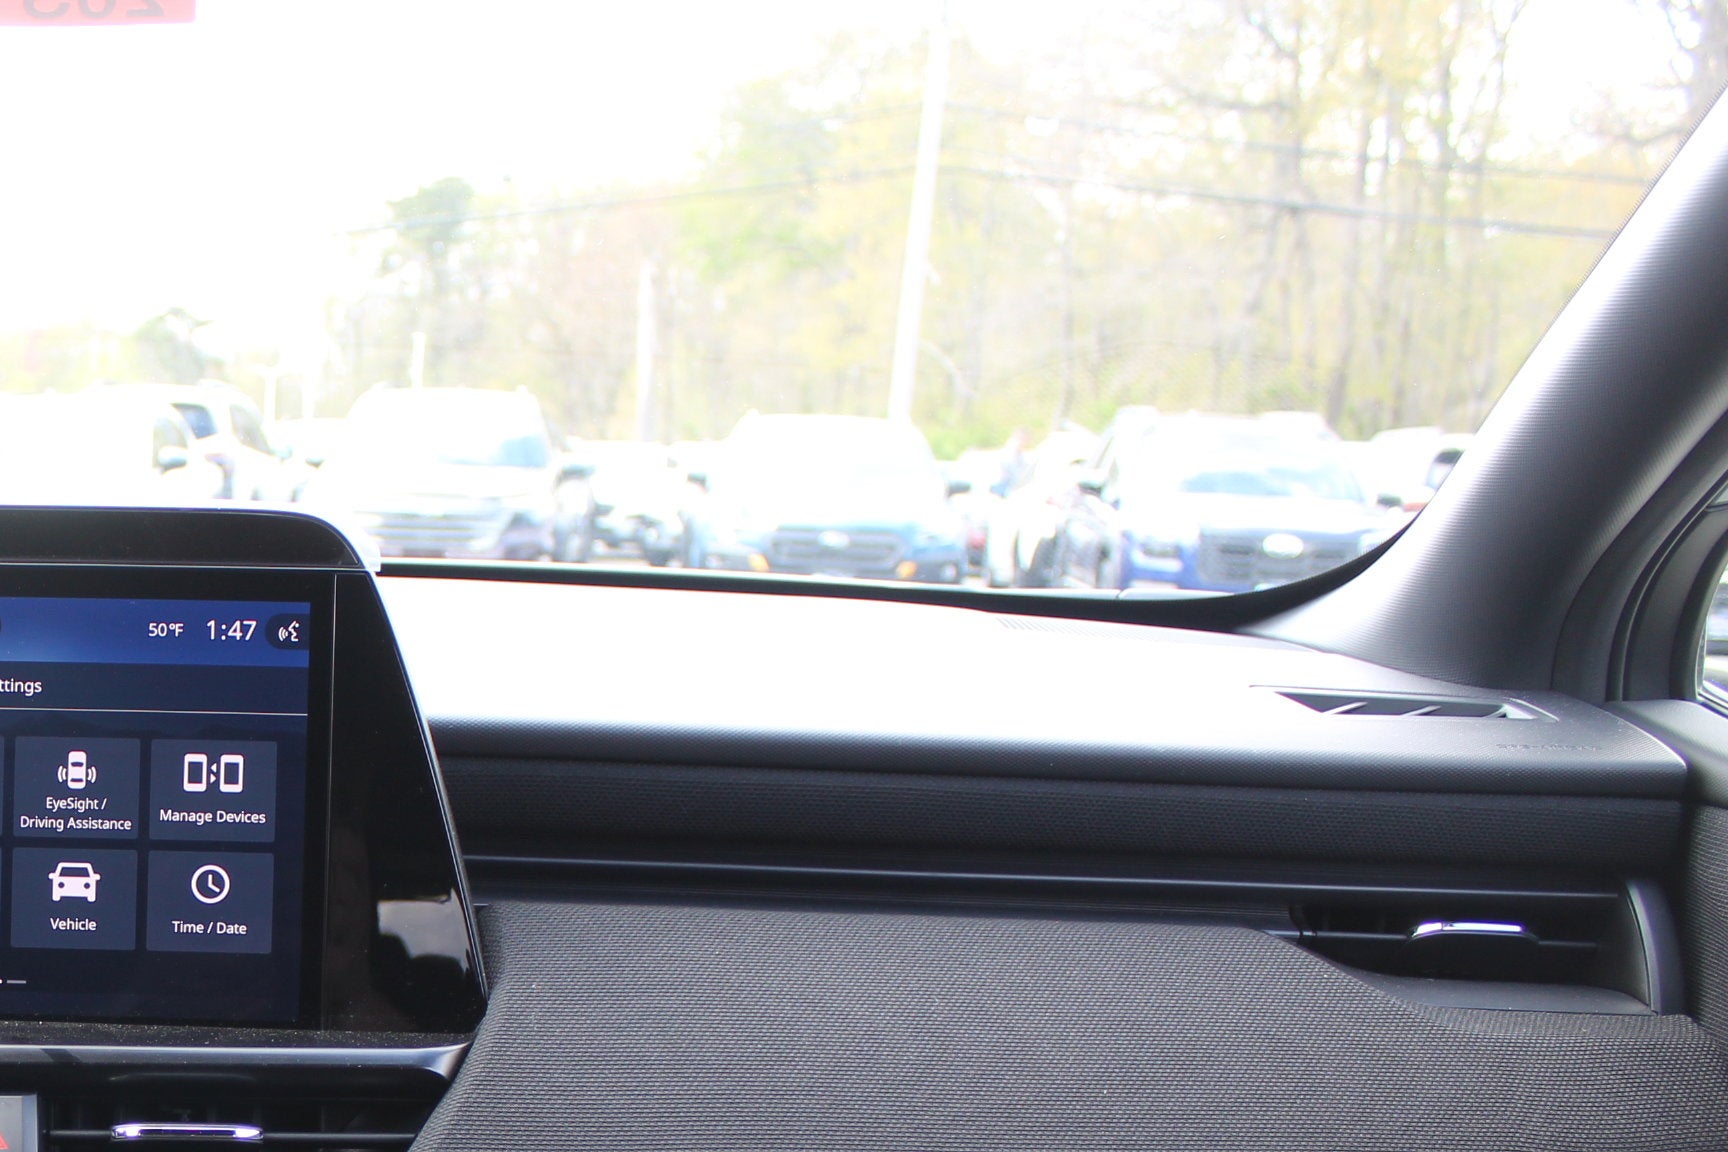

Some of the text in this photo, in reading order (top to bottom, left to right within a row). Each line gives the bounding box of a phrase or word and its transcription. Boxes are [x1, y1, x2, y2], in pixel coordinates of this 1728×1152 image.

[148, 620, 258, 641] 50°F 1:47
[46, 796, 108, 812] EyeSight /
[20, 816, 132, 832] Driving Assistance
[160, 809, 266, 825] Manage Devices
[50, 918, 97, 930] Vehicle
[172, 920, 248, 934] Time / Date
